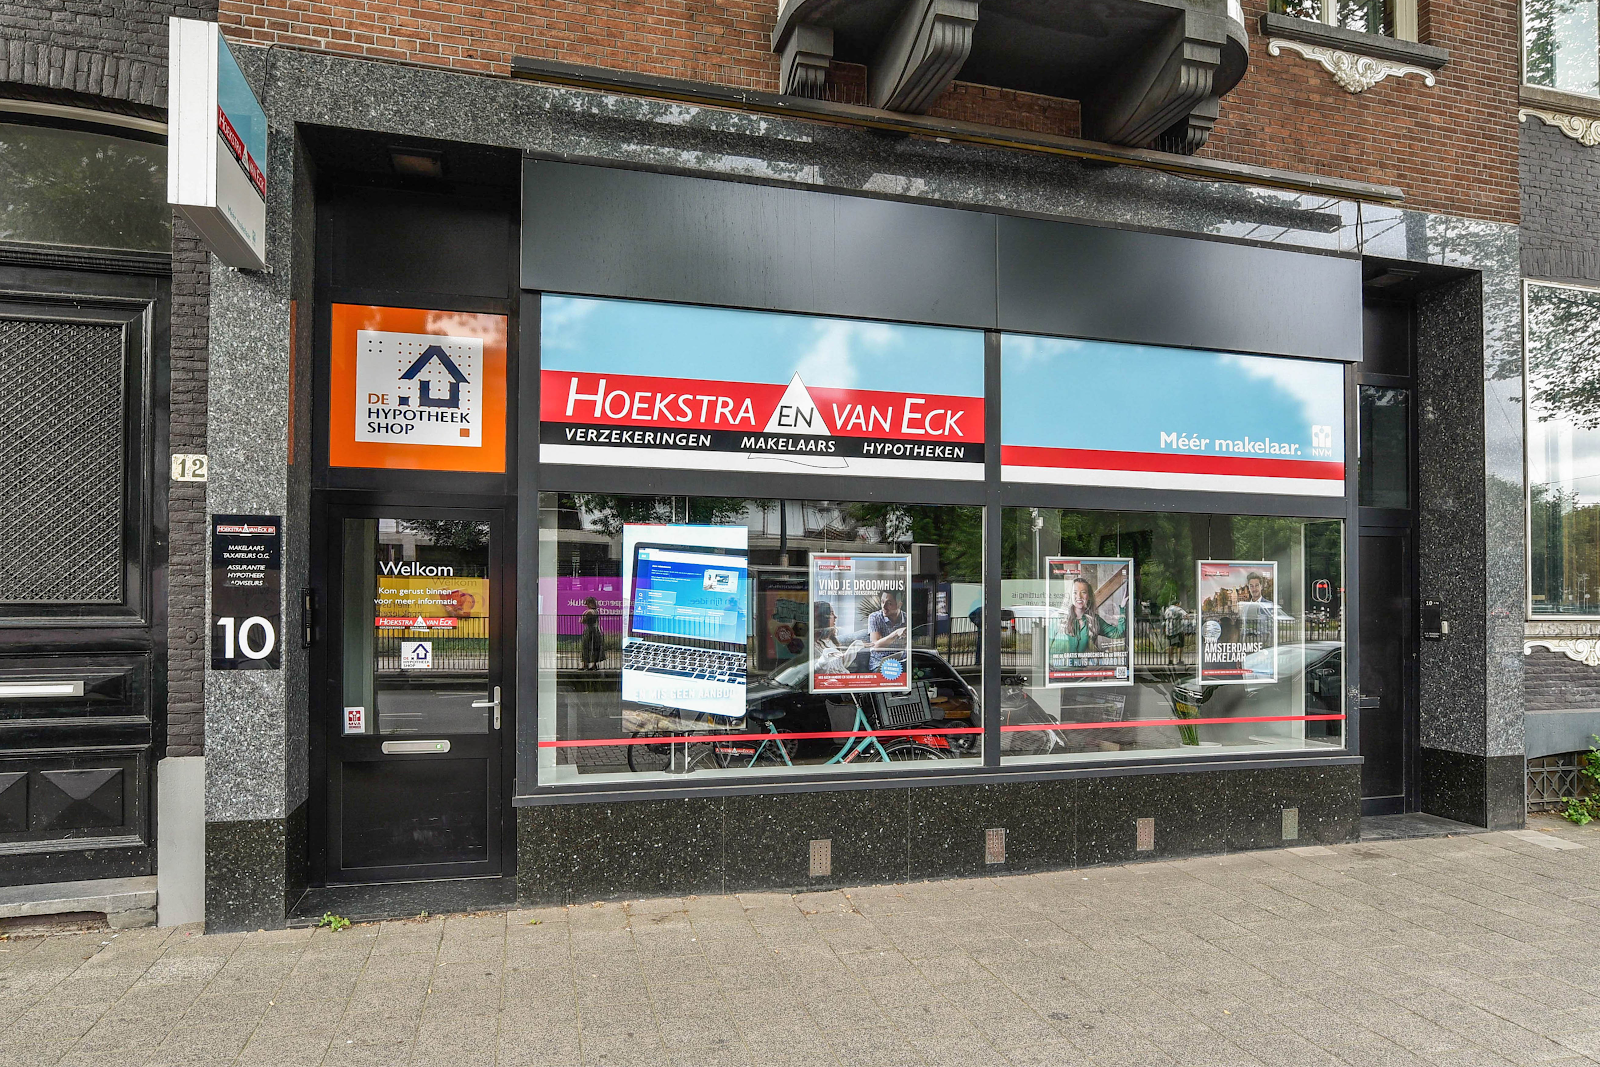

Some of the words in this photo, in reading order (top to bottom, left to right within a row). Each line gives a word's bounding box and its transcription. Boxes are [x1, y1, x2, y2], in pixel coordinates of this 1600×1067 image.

[367, 392, 390, 405] DE
[565, 377, 757, 426] HOEKSTRA
[776, 405, 814, 428] EN
[831, 403, 893, 433] VAN
[901, 398, 965, 437] ECK
[367, 407, 471, 424] HYPOTHEEK
[367, 421, 415, 435] SHOP
[564, 427, 712, 447] VERZEKERINGEN
[740, 436, 837, 453] MAKELAARS
[862, 442, 965, 459] HYPOTHEKEN
[1160, 431, 1210, 451] Méér
[1215, 436, 1302, 456] makelaar.
[1311, 447, 1333, 458] NVM
[178, 458, 206, 479] 12
[379, 561, 454, 577] Welkom
[818, 579, 840, 591] VIND
[841, 579, 851, 591] JE
[853, 579, 904, 591] DROOMHUIS
[378, 587, 397, 595] Kom
[399, 588, 424, 597] gerust
[426, 587, 452, 595] binnen
[417, 597, 458, 606] informatie
[379, 618, 413, 626] HOEKSTRA
[439, 618, 453, 626] ECK
[216, 616, 276, 660] 10
[1204, 642, 1264, 653] AMSTERDAMSE
[1073, 658, 1088, 667] HUIS
[1204, 652, 1247, 663] MAKELAAR
[670, 688, 695, 699] GEEN
